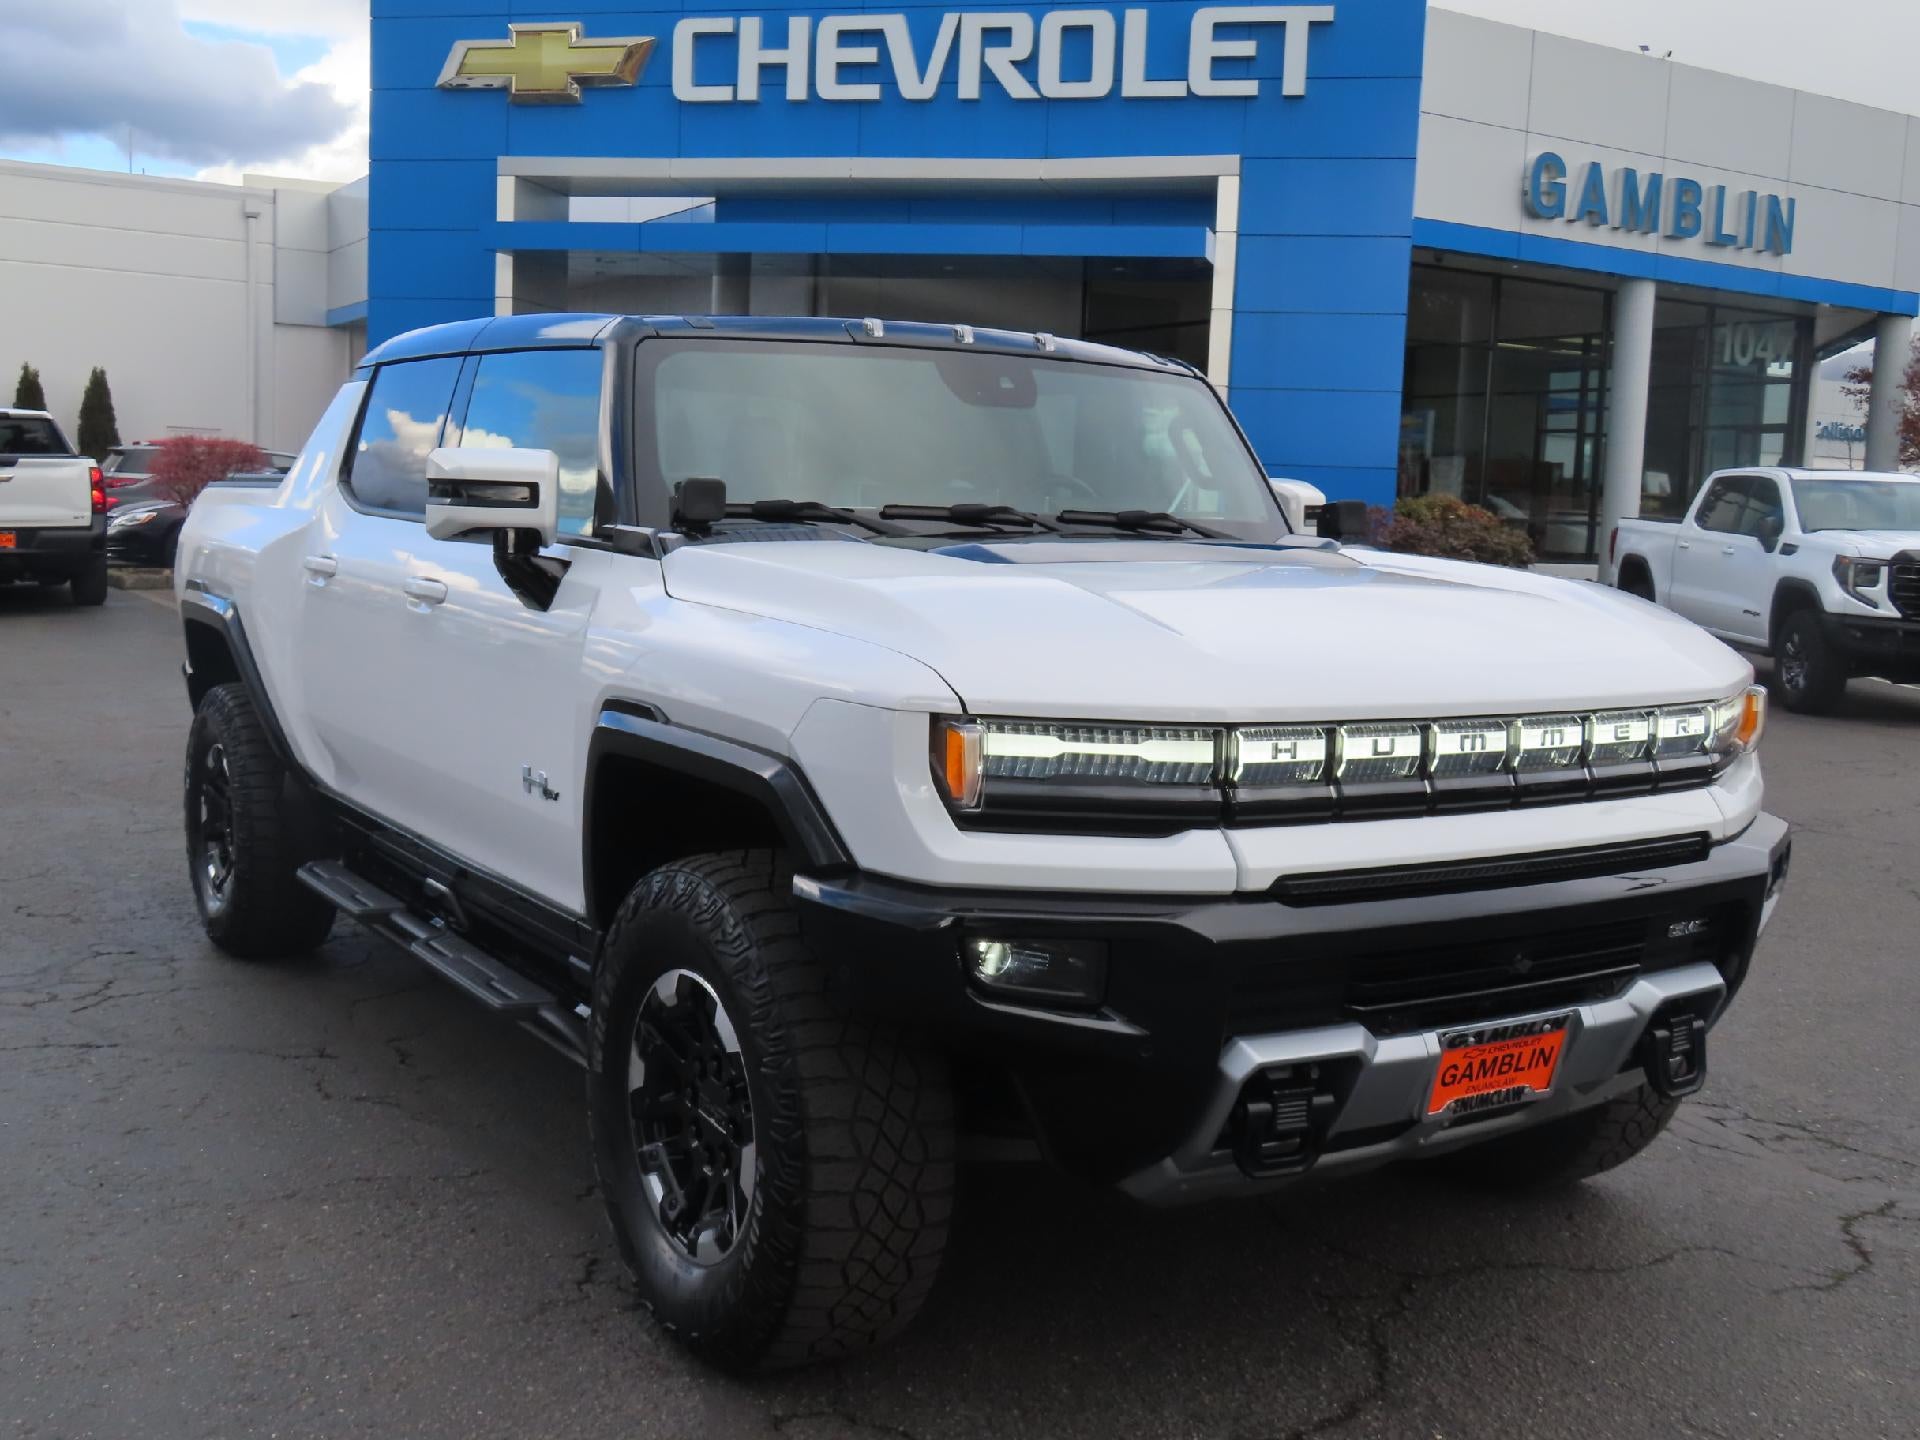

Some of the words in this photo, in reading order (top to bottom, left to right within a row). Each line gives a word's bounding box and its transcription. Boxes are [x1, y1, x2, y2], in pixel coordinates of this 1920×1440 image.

[672, 6, 1334, 101] CHEVROLET
[1526, 152, 1796, 256] GAMBLIN
[1440, 1045, 1555, 1088] GAMBLIN
